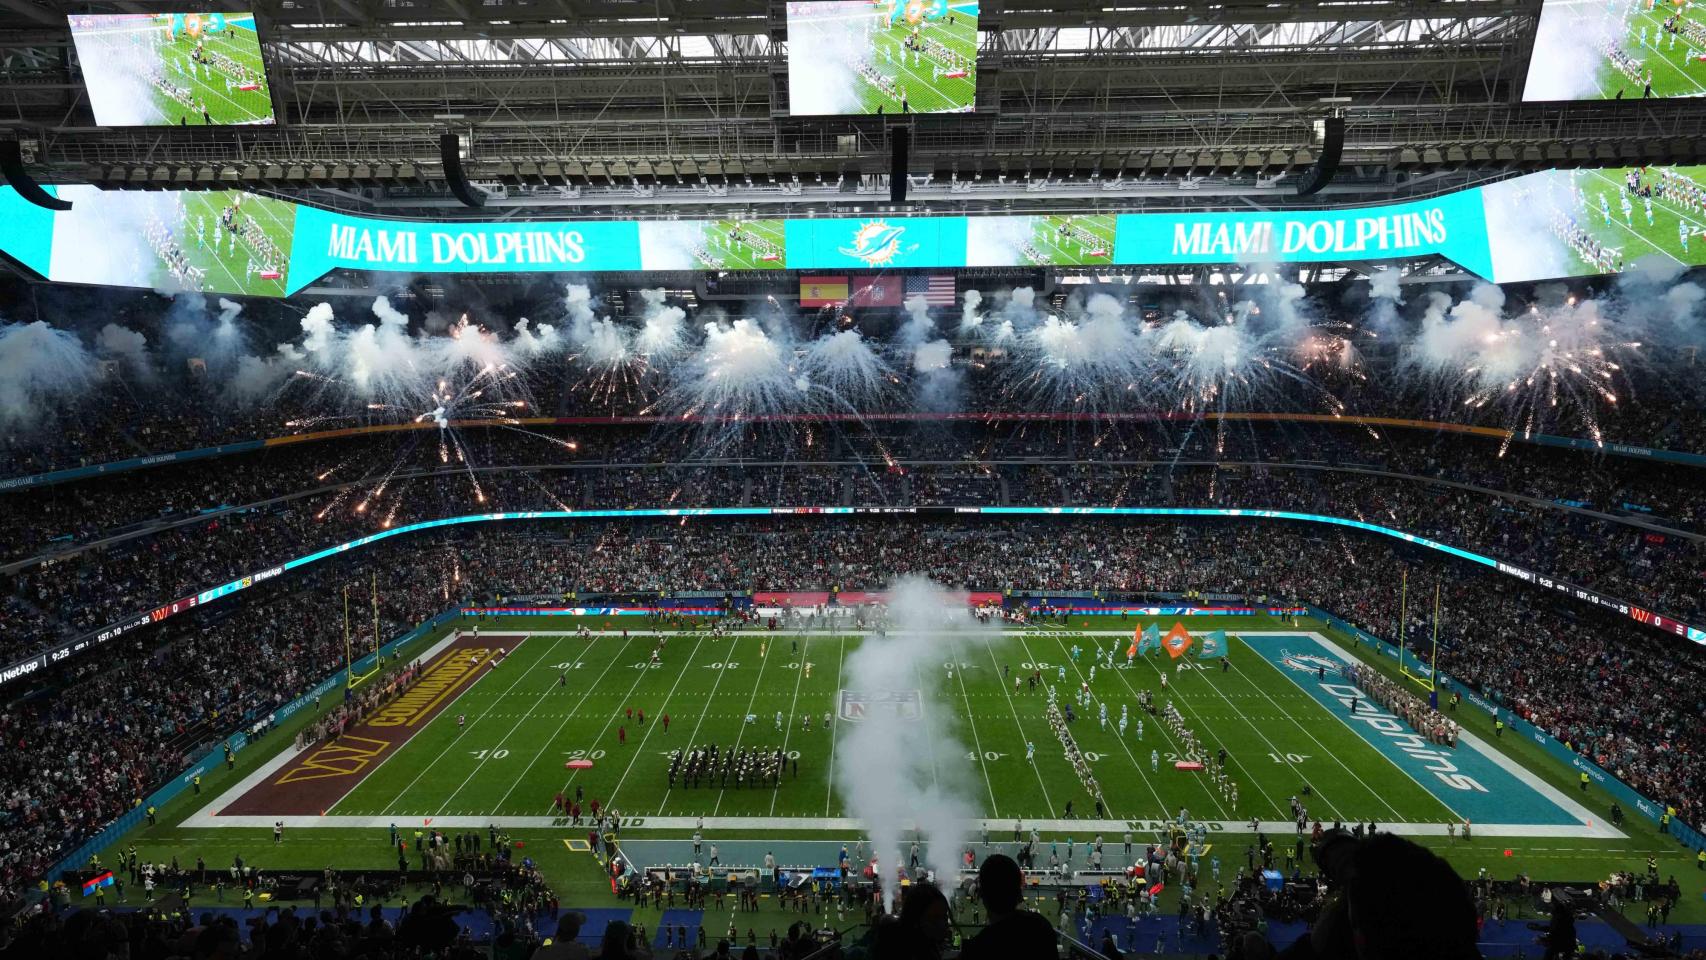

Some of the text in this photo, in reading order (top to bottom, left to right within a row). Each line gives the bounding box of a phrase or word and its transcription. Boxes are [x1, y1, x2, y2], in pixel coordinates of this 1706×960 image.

[1172, 207, 1447, 255] MIAMI DOLPHINS
[328, 223, 584, 264] MIAMI DOLPHINS
[262, 567, 282, 580] NetApp
[1506, 565, 1530, 580] NetApp
[1539, 576, 1553, 588] 9:25
[1576, 590, 1588, 601] 1ST
[1591, 595, 1599, 604] 10
[1619, 605, 1628, 614] 35
[173, 604, 178, 613] 0
[1654, 615, 1662, 626] 0
[3, 661, 39, 682] NetApp
[52, 648, 70, 662] 9:25
[98, 631, 110, 643] 1ST
[113, 628, 122, 636] 10
[141, 616, 150, 625] 35
[367, 648, 489, 727] COMMANDERS
[283, 677, 337, 718] 2025 NFL MADRID GAME
[1318, 683, 1490, 793] Dolphins
[1534, 732, 1546, 744] VISA
[474, 749, 510, 760] 10
[568, 749, 606, 760] 20
[1267, 752, 1305, 764] 10
[1579, 761, 1605, 783] Santander
[1636, 799, 1656, 818] FedEx
[551, 818, 645, 827] MADID
[1126, 821, 1223, 831] MADRD
